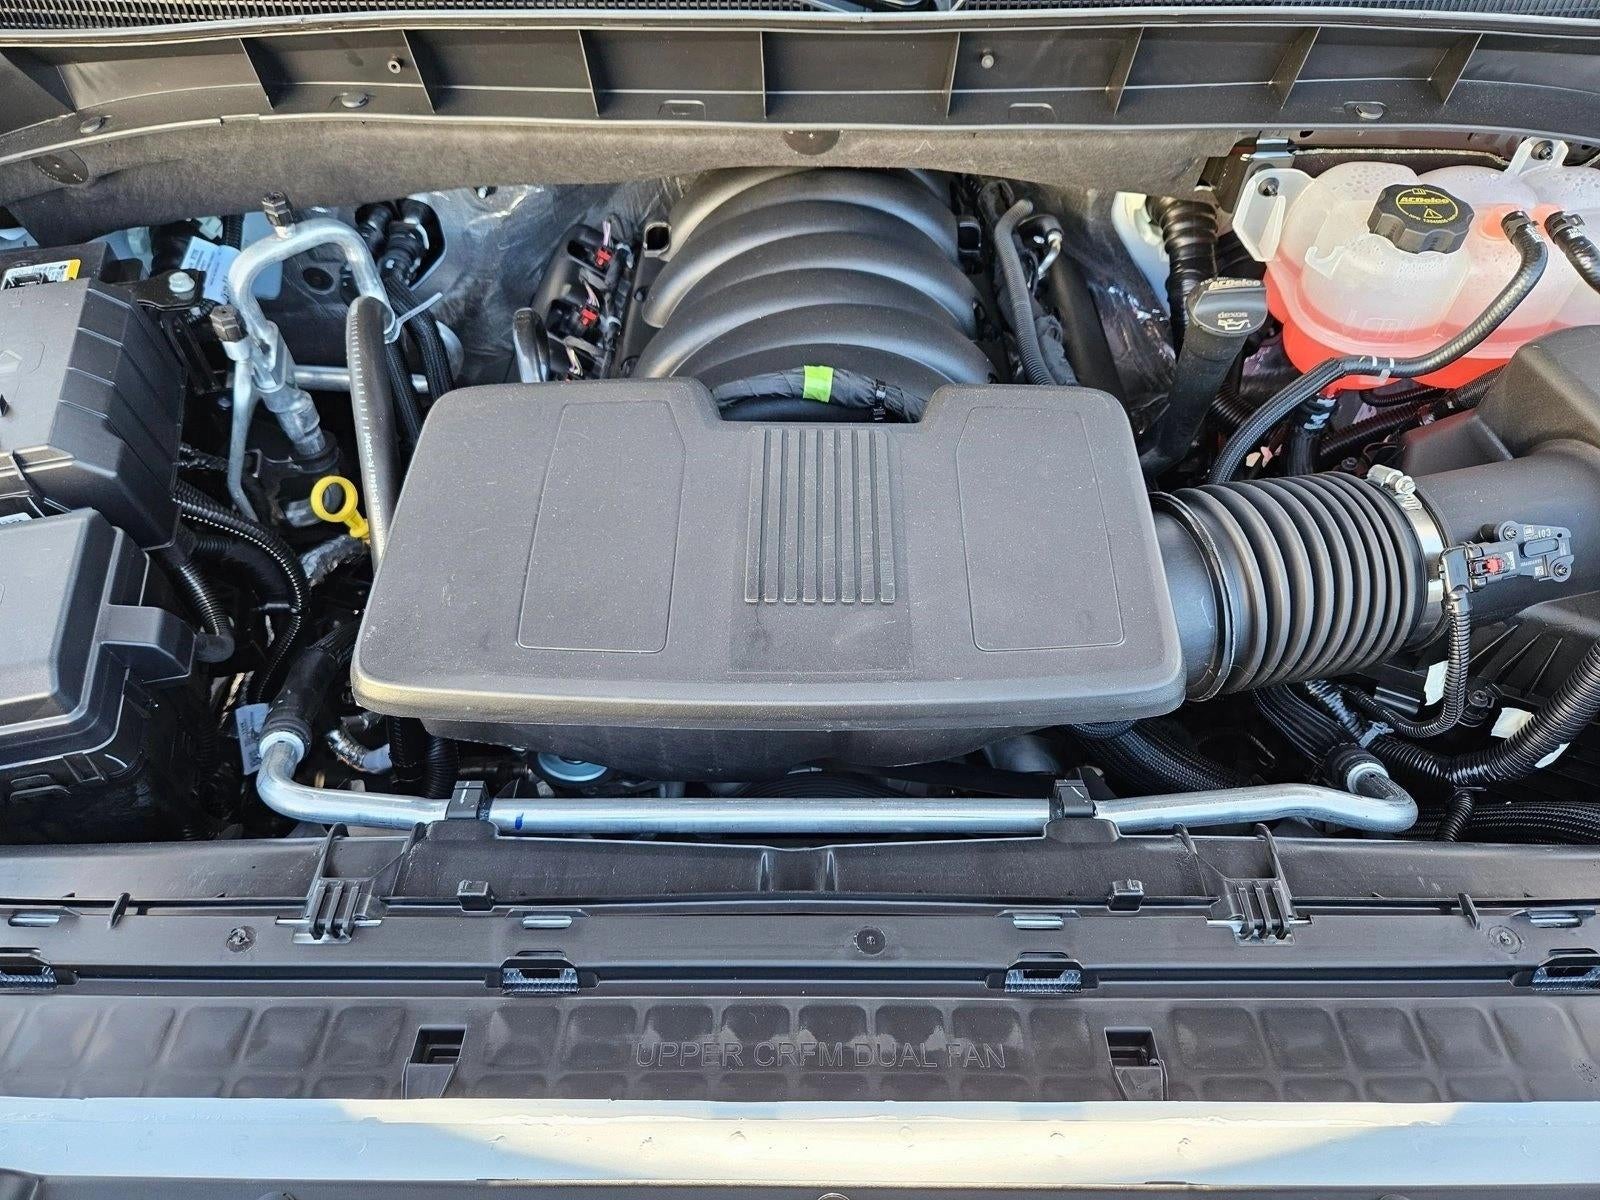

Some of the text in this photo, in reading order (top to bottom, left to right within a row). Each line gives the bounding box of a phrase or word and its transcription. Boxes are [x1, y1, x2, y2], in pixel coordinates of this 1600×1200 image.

[635, 1041, 1006, 1068] UPPER CRFM DUAL FAN
